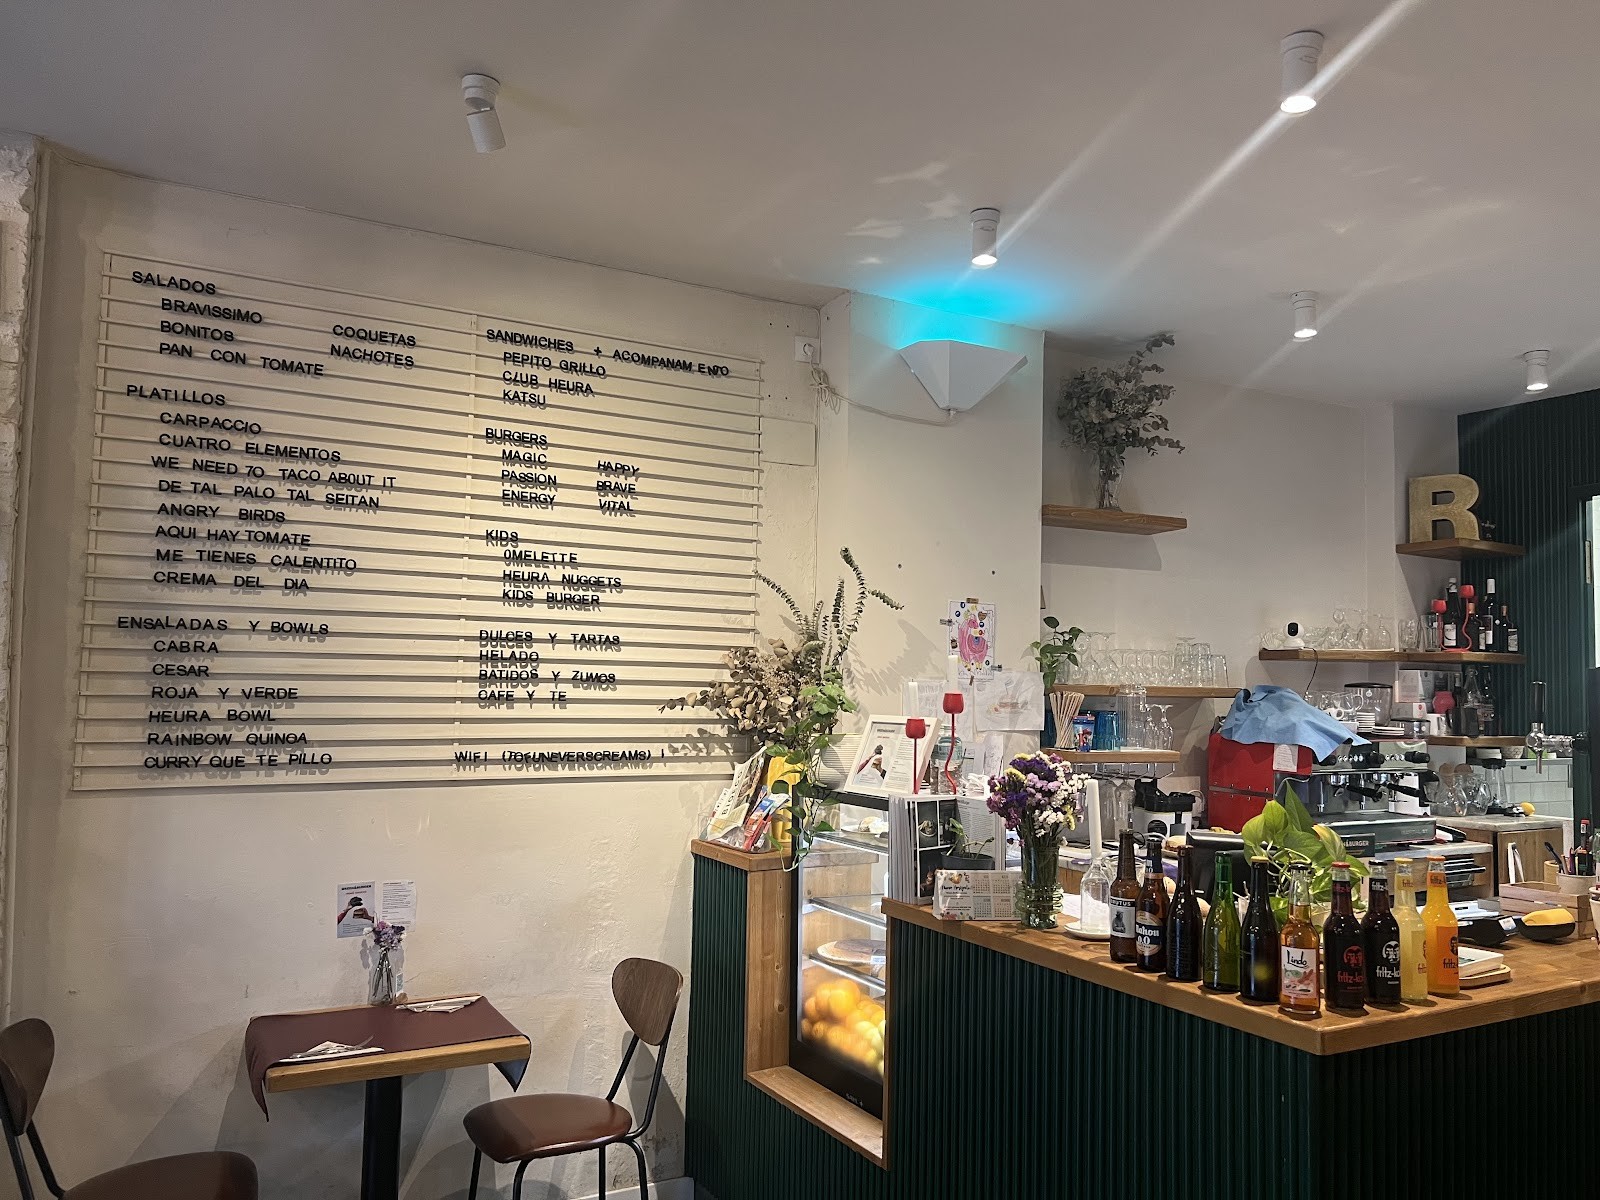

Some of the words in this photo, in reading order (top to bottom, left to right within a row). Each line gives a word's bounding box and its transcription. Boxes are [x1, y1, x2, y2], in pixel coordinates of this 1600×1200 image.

[131, 271, 216, 295] SALADOS
[161, 298, 263, 324] BRAVISSIMO
[160, 321, 234, 342] BONITOS
[333, 325, 416, 347] COQUETAS
[487, 329, 573, 353] SANDWICHES
[158, 343, 192, 358] PAN
[211, 350, 248, 365] CON
[260, 357, 324, 376] TOMATE
[330, 344, 414, 367] NACHOTES
[503, 352, 551, 367] PEPITO
[560, 358, 606, 377] GRILLO
[503, 371, 538, 385] CLUB
[548, 378, 593, 395] HEURA
[127, 385, 225, 406] PLATILLOS
[503, 390, 545, 405] KATSU
[160, 412, 261, 435] CARPACCIO
[485, 428, 547, 446] BURGERS
[159, 433, 231, 450] CUATRO
[245, 443, 340, 462] ELEMENTOS
[502, 449, 546, 464] MAGIC
[151, 456, 179, 469] WE
[192, 459, 237, 474] NEED
[279, 469, 320, 482] TACO
[383, 477, 396, 488] IT
[597, 461, 639, 476] HAPPY
[502, 470, 557, 486] PASSION
[596, 481, 636, 493] BRAVE
[159, 480, 181, 492] DE
[191, 482, 221, 495] TAL
[234, 486, 275, 499] PALO
[287, 489, 315, 501] TAL
[326, 493, 379, 508] SEITAN
[502, 490, 555, 505] ENERGY
[157, 504, 220, 517] ANGRY
[238, 508, 285, 522] BIRDS
[599, 499, 634, 511] VITAL
[1408, 474, 1480, 543] R
[155, 526, 196, 539] AQUI
[207, 529, 240, 541] HAY
[245, 530, 311, 546] TOMATE
[486, 530, 518, 542] KIDS
[156, 549, 183, 561] ME
[196, 550, 256, 564] TIENES
[271, 555, 357, 570] CALENTITO
[154, 572, 217, 585] CREMA
[234, 575, 264, 587] DEL
[284, 578, 309, 590] DIA
[503, 571, 549, 582] HEURA
[562, 574, 621, 588] NUGGETS
[503, 589, 533, 600] KIDS
[546, 592, 599, 605] BURGER
[118, 616, 227, 632] ENSALADAS
[249, 621, 260, 632] Y
[271, 622, 329, 635] BOWLS
[154, 640, 219, 653] CABRA
[479, 630, 532, 641] DULCES
[549, 633, 557, 643] Y
[571, 634, 619, 645] TARTAS
[479, 650, 539, 663] HELADO
[153, 664, 209, 677] CESAR
[479, 669, 538, 681] BATIDOS
[552, 671, 560, 681] Y
[572, 671, 615, 683] ZUMOS
[151, 687, 198, 699] ROJA
[218, 688, 229, 699] Y
[241, 687, 298, 699] VERDE
[478, 690, 514, 701] CAFE
[526, 691, 535, 700] Y
[552, 692, 566, 701] TE
[149, 710, 211, 723] HEURA
[227, 710, 275, 722] BOWL
[147, 733, 232, 746] RAINBOW
[246, 733, 307, 745] QUINOA
[144, 755, 203, 769] CURRY
[210, 756, 245, 767] QUE
[256, 755, 278, 766] TE
[289, 753, 332, 765] PILLO
[455, 751, 487, 763] WIFI
[1286, 949, 1308, 968] Lindo
